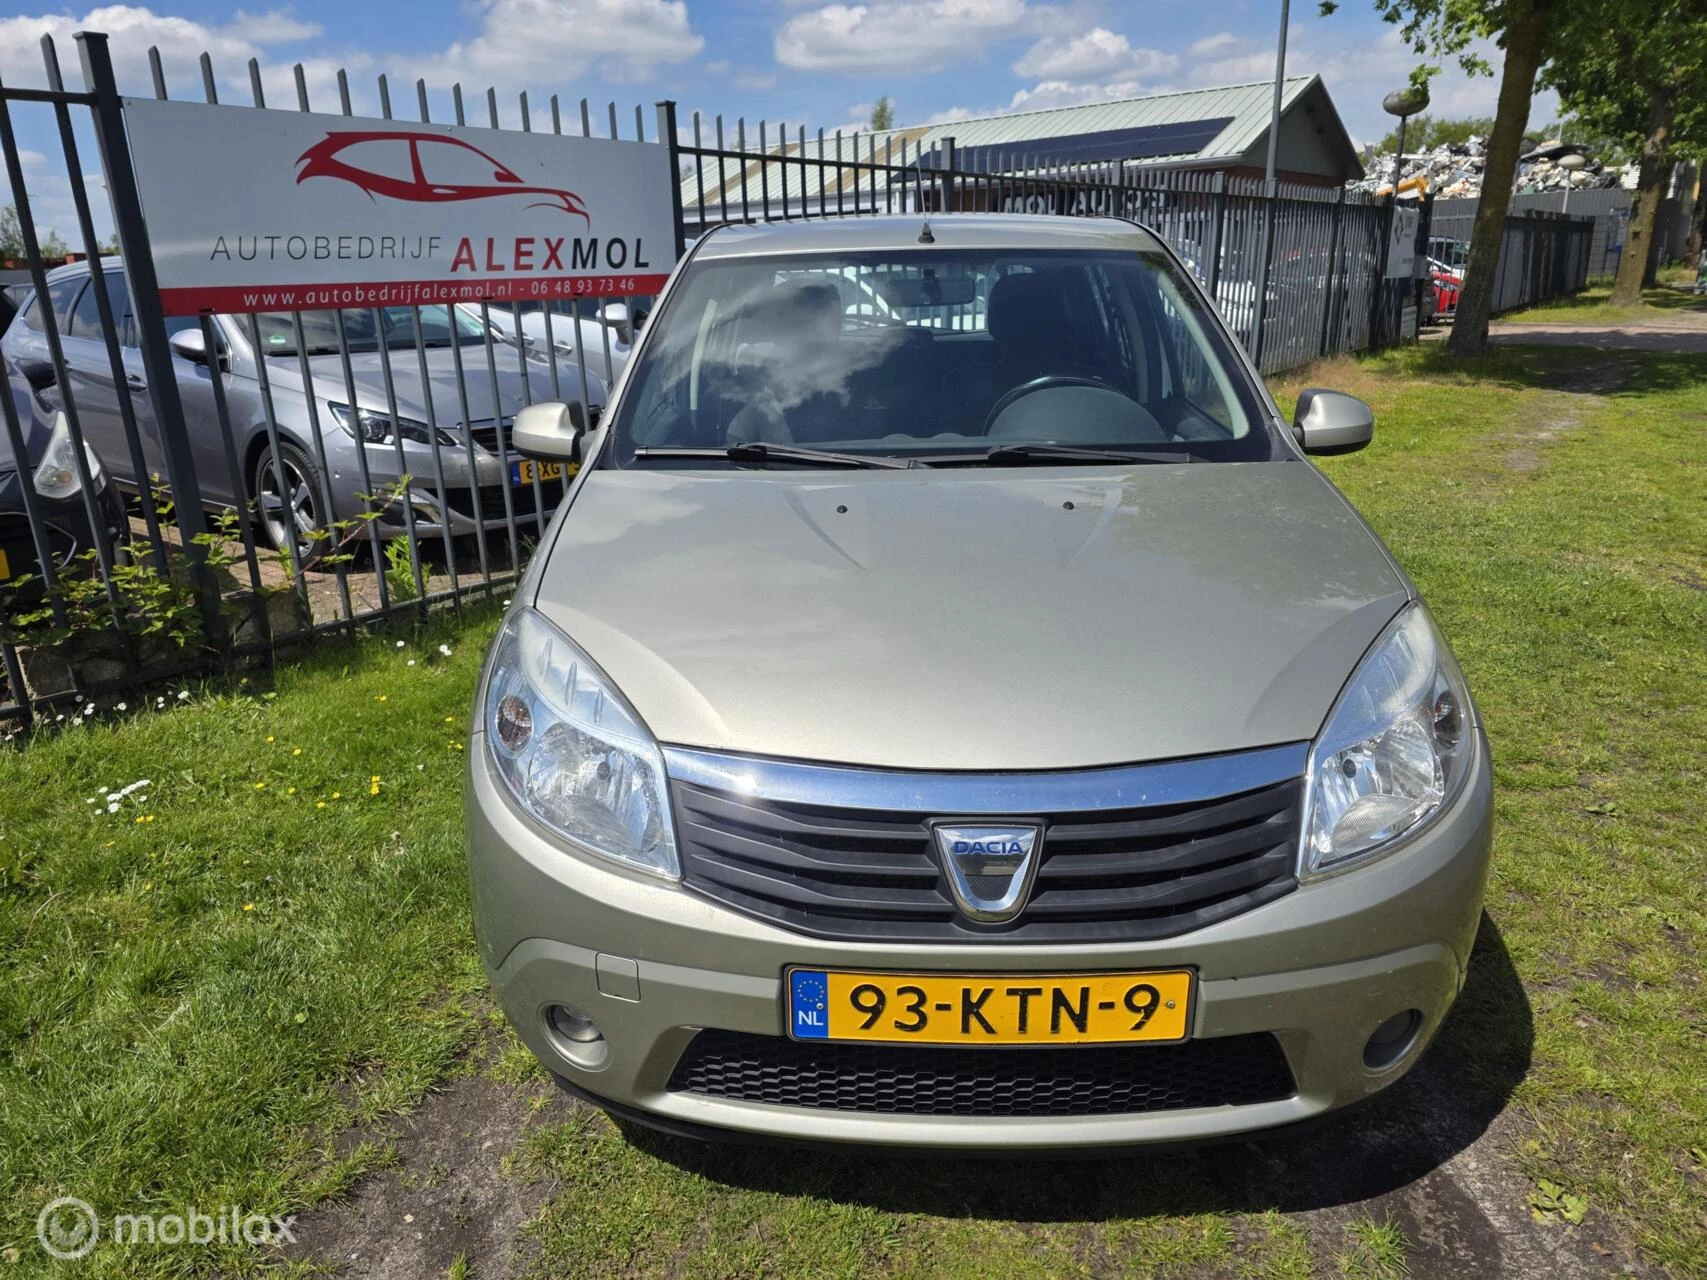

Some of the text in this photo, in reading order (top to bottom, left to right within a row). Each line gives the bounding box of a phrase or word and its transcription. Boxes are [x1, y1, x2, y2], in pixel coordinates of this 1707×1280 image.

[210, 235, 650, 273] AUTOBEDRIJF ALEXMOL
[243, 280, 513, 307] www.autobedrijfalexmol.nl
[531, 280, 548, 295] 06
[554, 279, 572, 294] 48
[576, 278, 593, 294] 93
[599, 278, 614, 292] 73
[619, 277, 635, 291] 46
[953, 841, 1024, 854] DACIA
[798, 1010, 824, 1026] NL
[849, 983, 1161, 1034] 93-KTN-9
